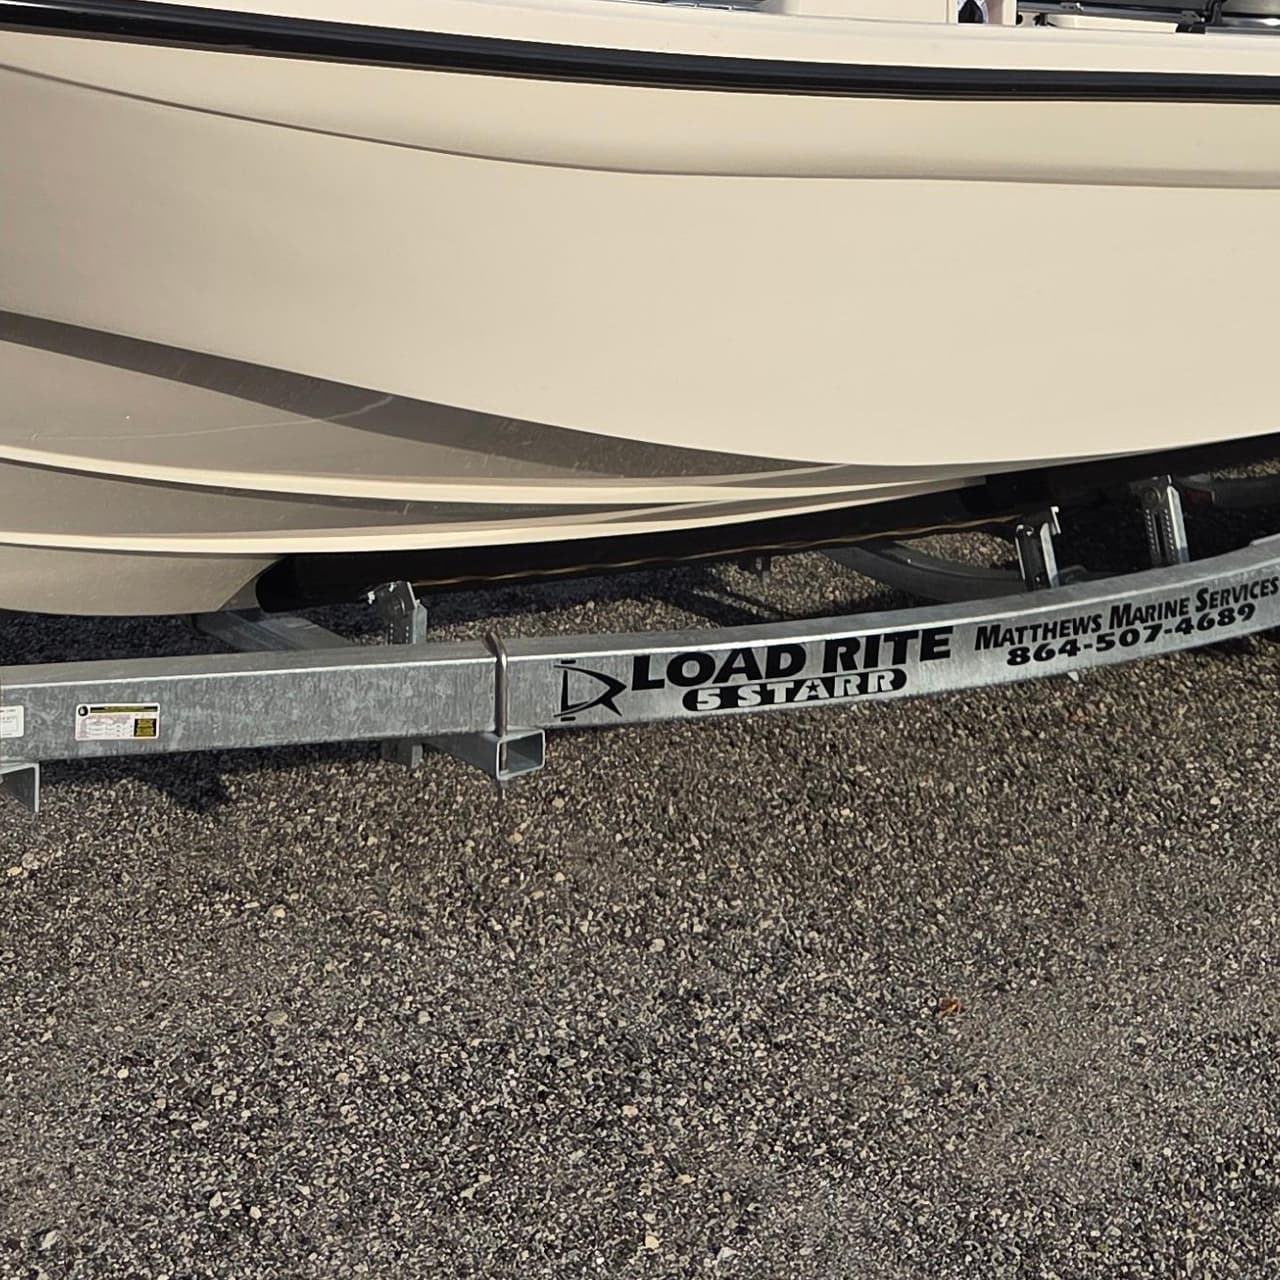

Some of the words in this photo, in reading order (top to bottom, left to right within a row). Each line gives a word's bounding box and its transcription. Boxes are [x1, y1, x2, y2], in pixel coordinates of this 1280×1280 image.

[975, 613, 1102, 651] MATTHEWS
[1108, 597, 1190, 628] MARINE
[1195, 576, 1280, 613] SERVICES
[1006, 603, 1256, 666] 864-507-4689
[631, 642, 807, 691] LOAD
[822, 625, 954, 674] RITE
[695, 687, 721, 712] 5
[737, 669, 895, 708] STARR
